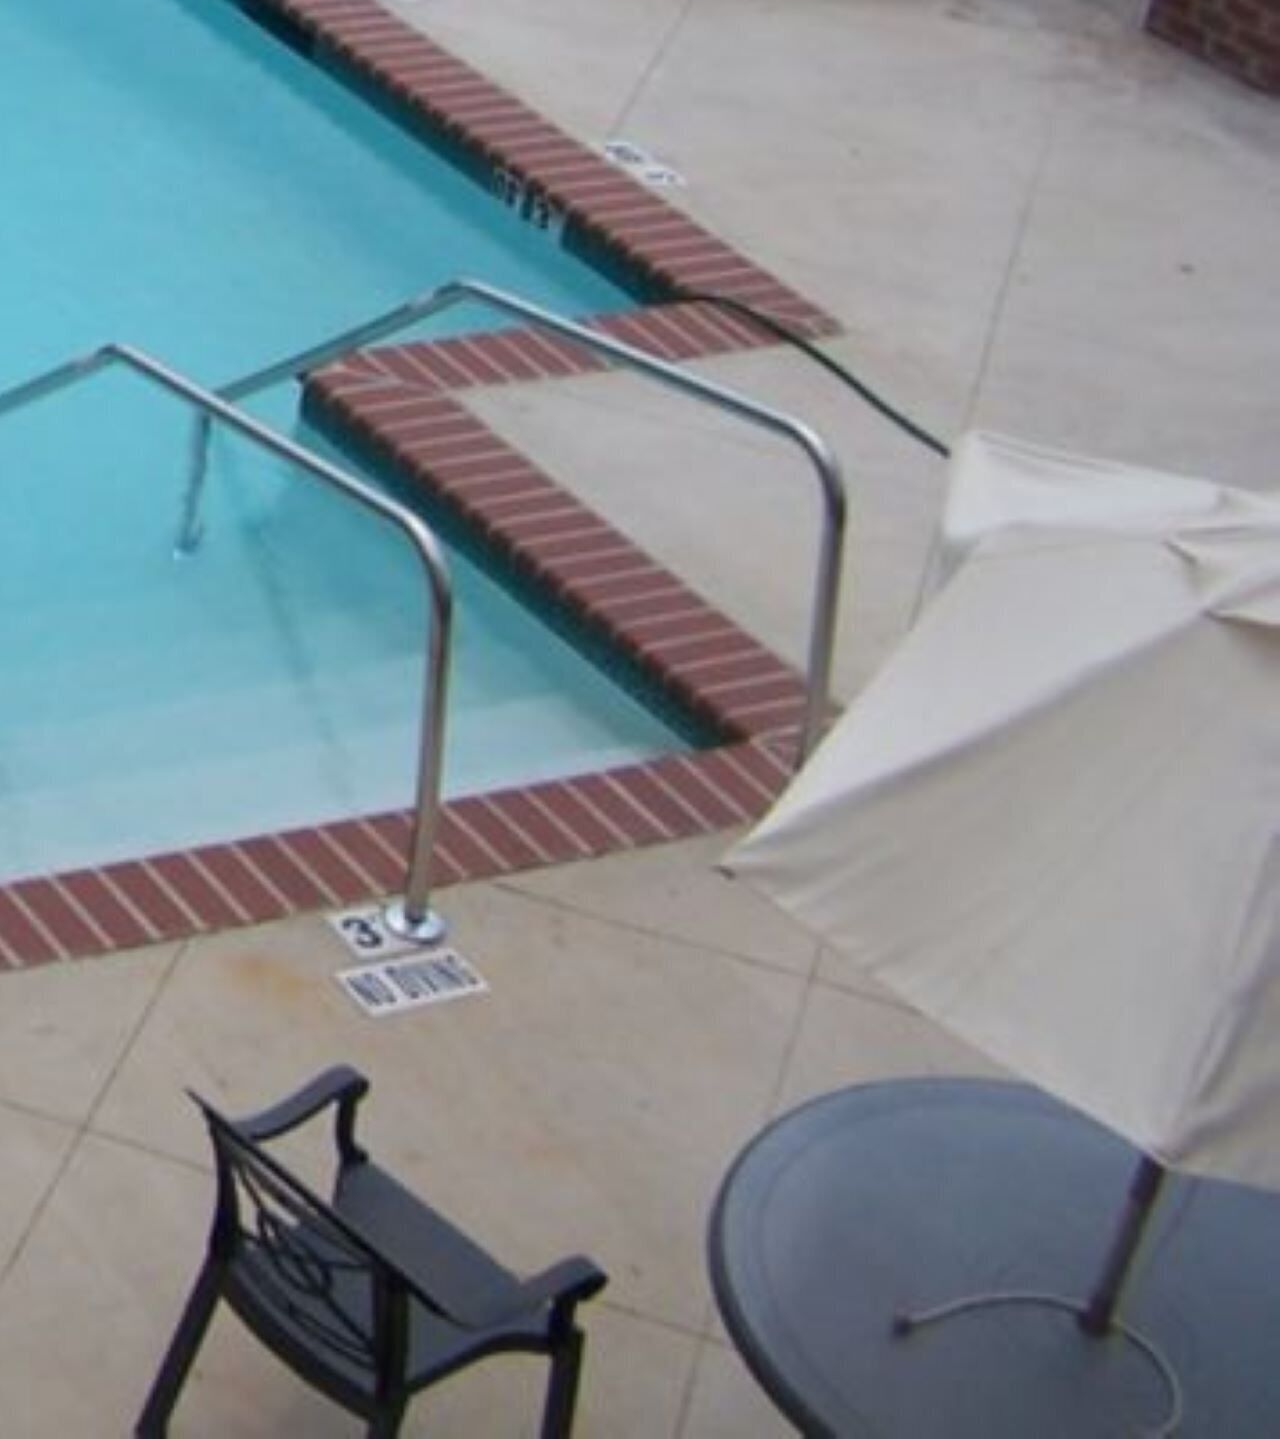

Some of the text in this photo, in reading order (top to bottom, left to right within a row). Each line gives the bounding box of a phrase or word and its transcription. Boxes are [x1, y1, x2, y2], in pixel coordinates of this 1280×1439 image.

[342, 917, 383, 948] 3
[345, 954, 478, 1006] NO DIVING
